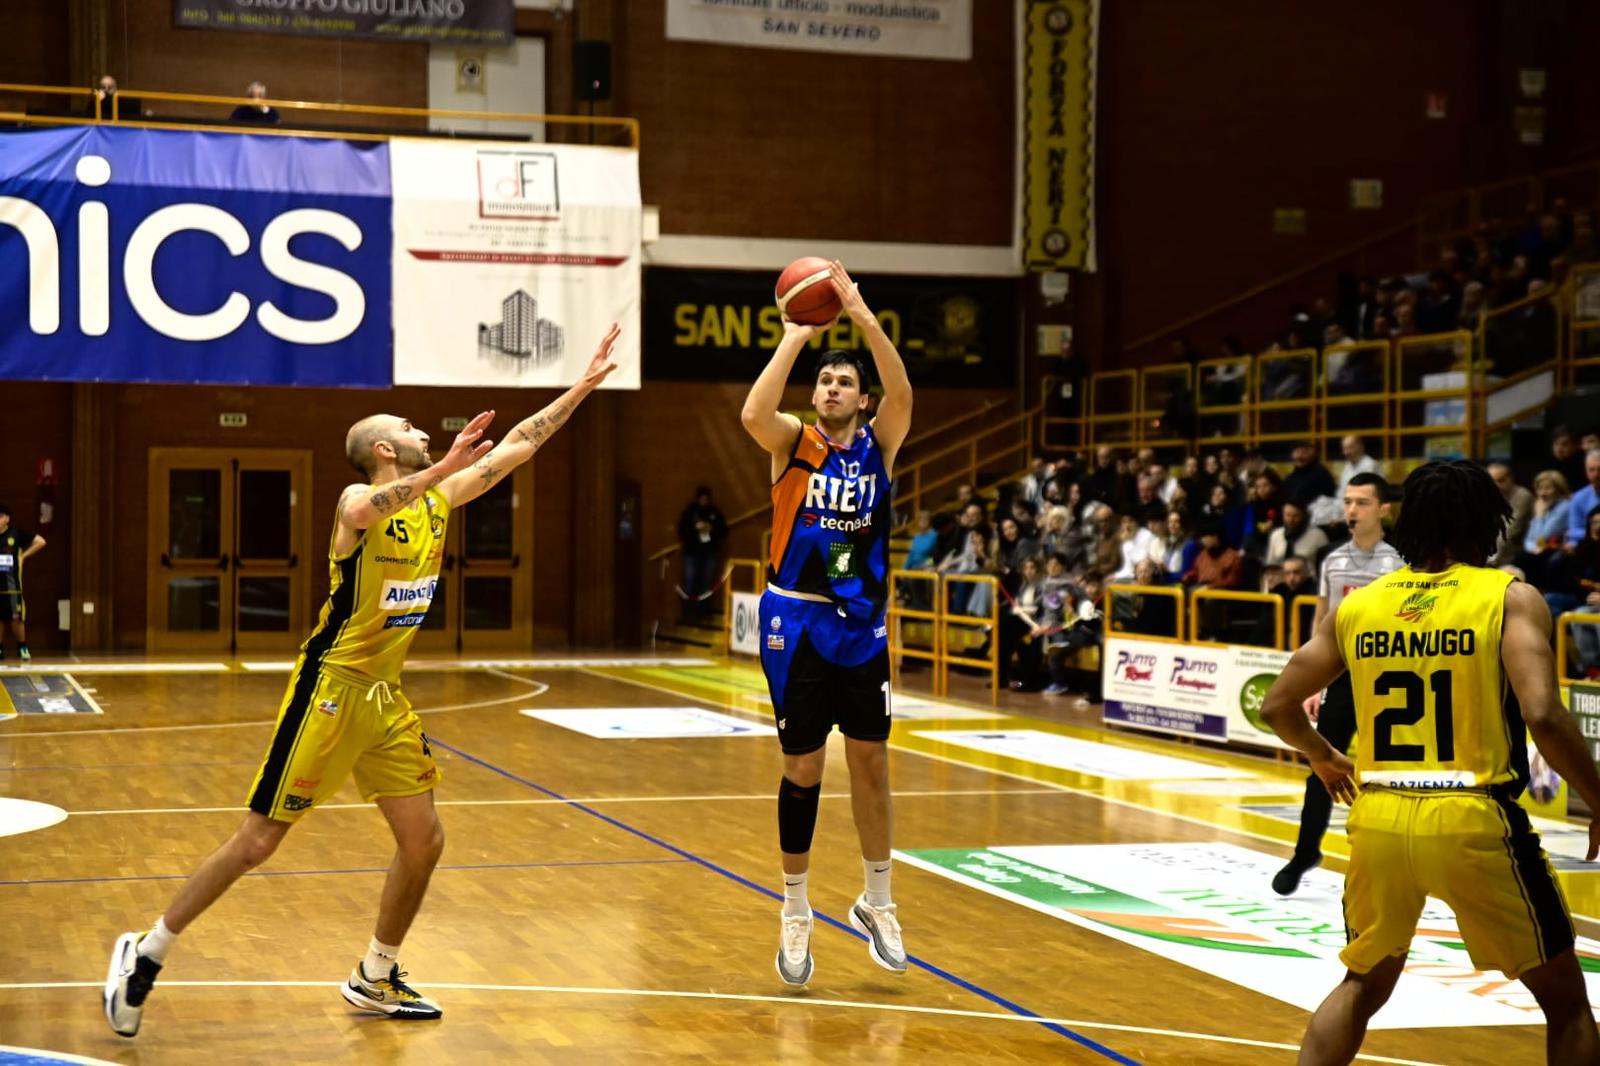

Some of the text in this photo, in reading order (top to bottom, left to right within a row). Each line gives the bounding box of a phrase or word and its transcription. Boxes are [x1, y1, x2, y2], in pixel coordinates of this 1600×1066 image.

[341, 0, 465, 20] GIULIANO
[764, 18, 881, 41] SAN SEVERO
[674, 303, 900, 351] SAN SERO
[839, 458, 861, 479] 10
[805, 472, 877, 513] RIETI
[385, 518, 409, 543] 45
[1415, 581, 1431, 590] SAN
[1356, 628, 1475, 660] IGBANUGO
[1374, 669, 1455, 762] 21
[1582, 716, 1600, 738] LE
[1390, 780, 1466, 789] PAZIENZA
